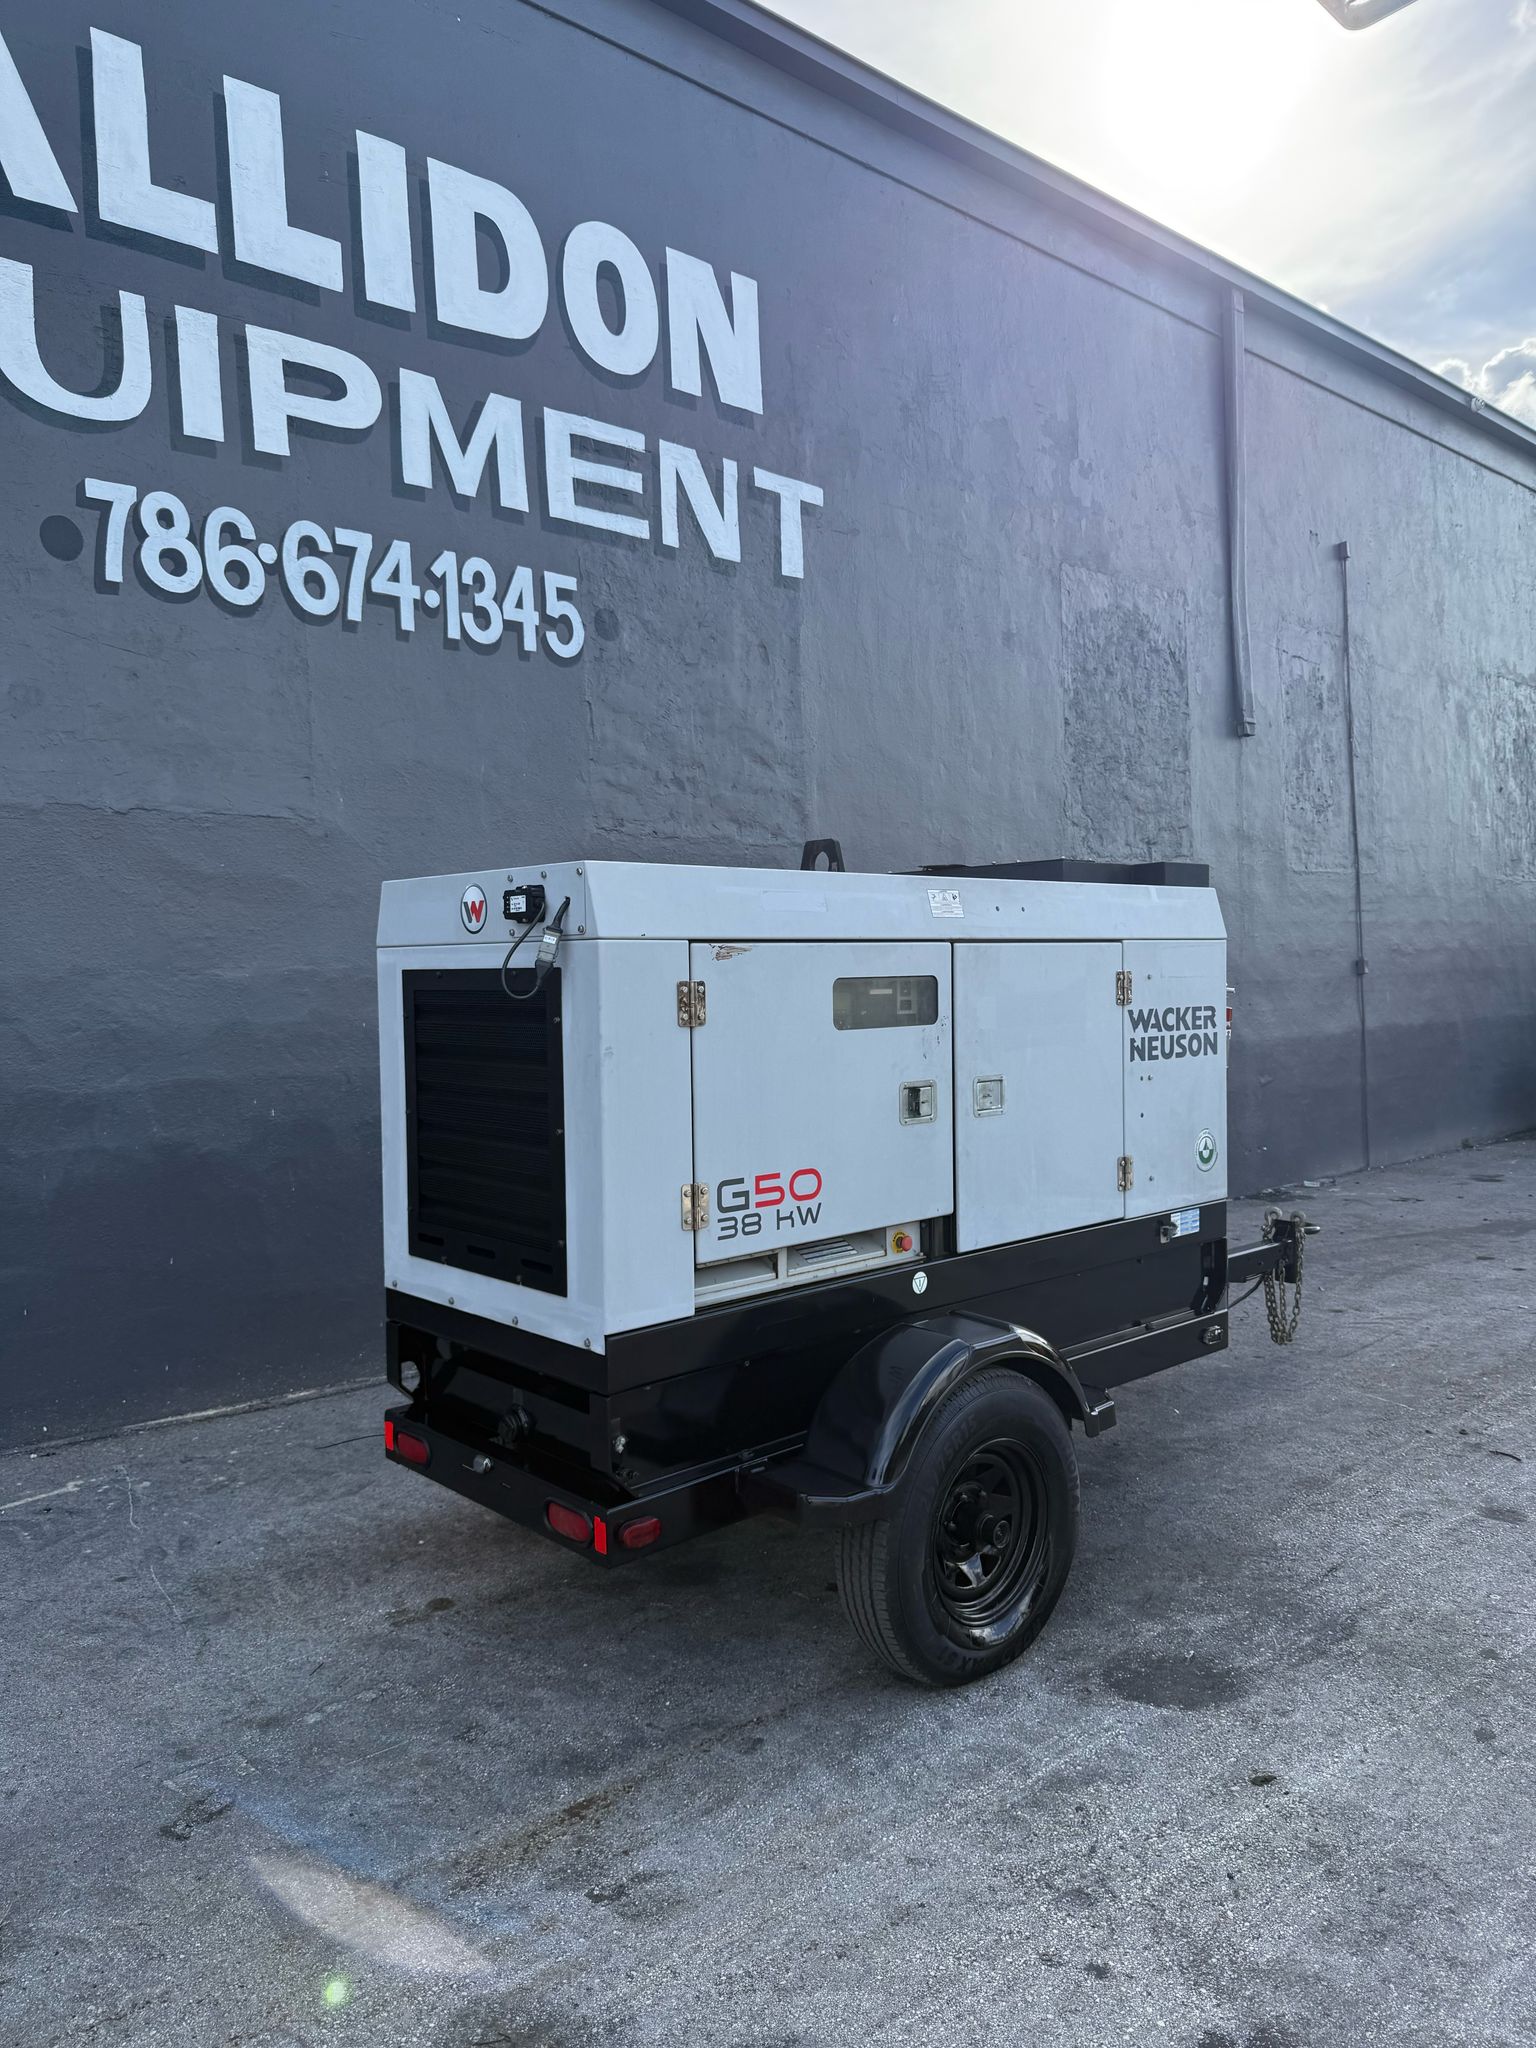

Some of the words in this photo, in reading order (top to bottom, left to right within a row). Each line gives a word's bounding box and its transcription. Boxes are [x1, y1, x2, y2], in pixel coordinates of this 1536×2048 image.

[0, 257, 823, 579] UIPMENT
[1128, 1006, 1217, 1033] WACKER
[1130, 1032, 1218, 1062] NEUSON
[717, 1168, 822, 1213] G50
[717, 1213, 761, 1240] 38
